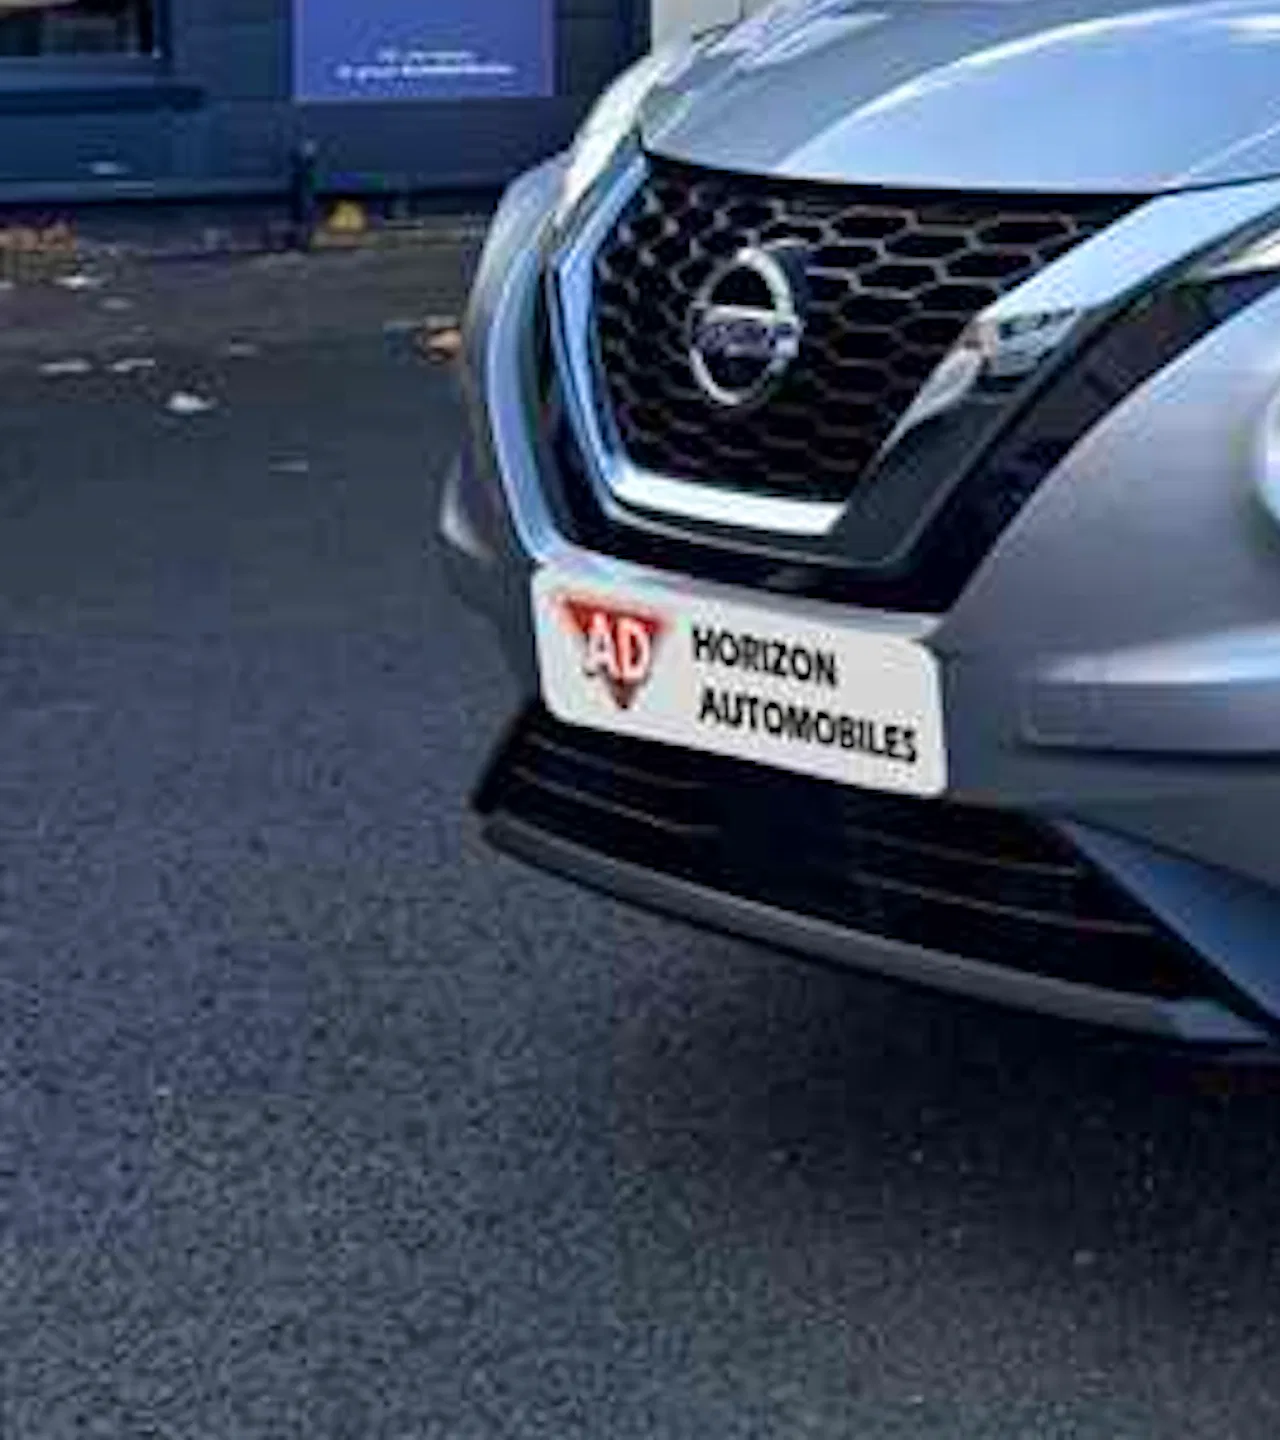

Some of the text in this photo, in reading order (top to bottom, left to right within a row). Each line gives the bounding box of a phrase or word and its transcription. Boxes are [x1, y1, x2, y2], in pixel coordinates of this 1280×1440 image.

[583, 610, 655, 682] AD
[692, 624, 838, 686] HORIZON
[699, 686, 918, 763] AUTOMOBILES
